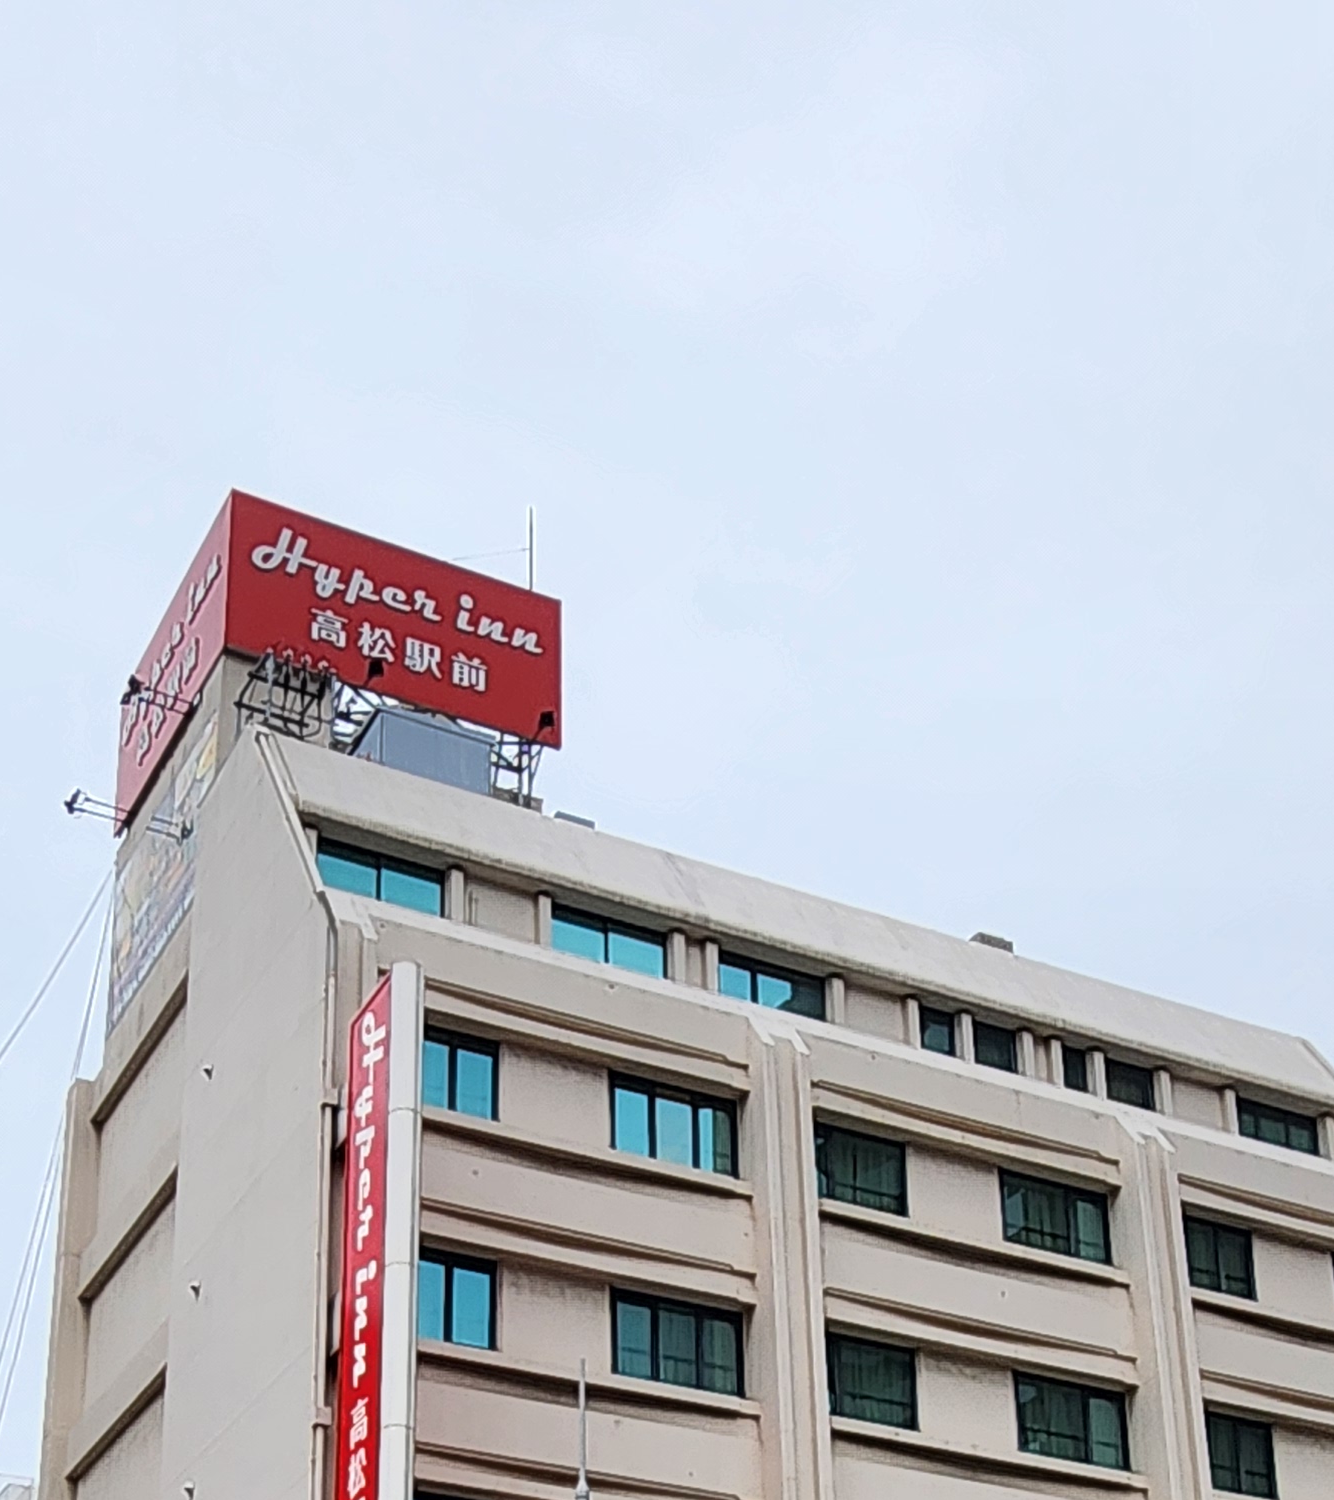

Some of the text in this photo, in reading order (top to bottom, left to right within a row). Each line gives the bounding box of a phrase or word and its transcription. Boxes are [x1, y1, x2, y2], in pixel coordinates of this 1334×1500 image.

[251, 527, 543, 654] Hyper inn
[310, 606, 487, 692] 高松駅前
